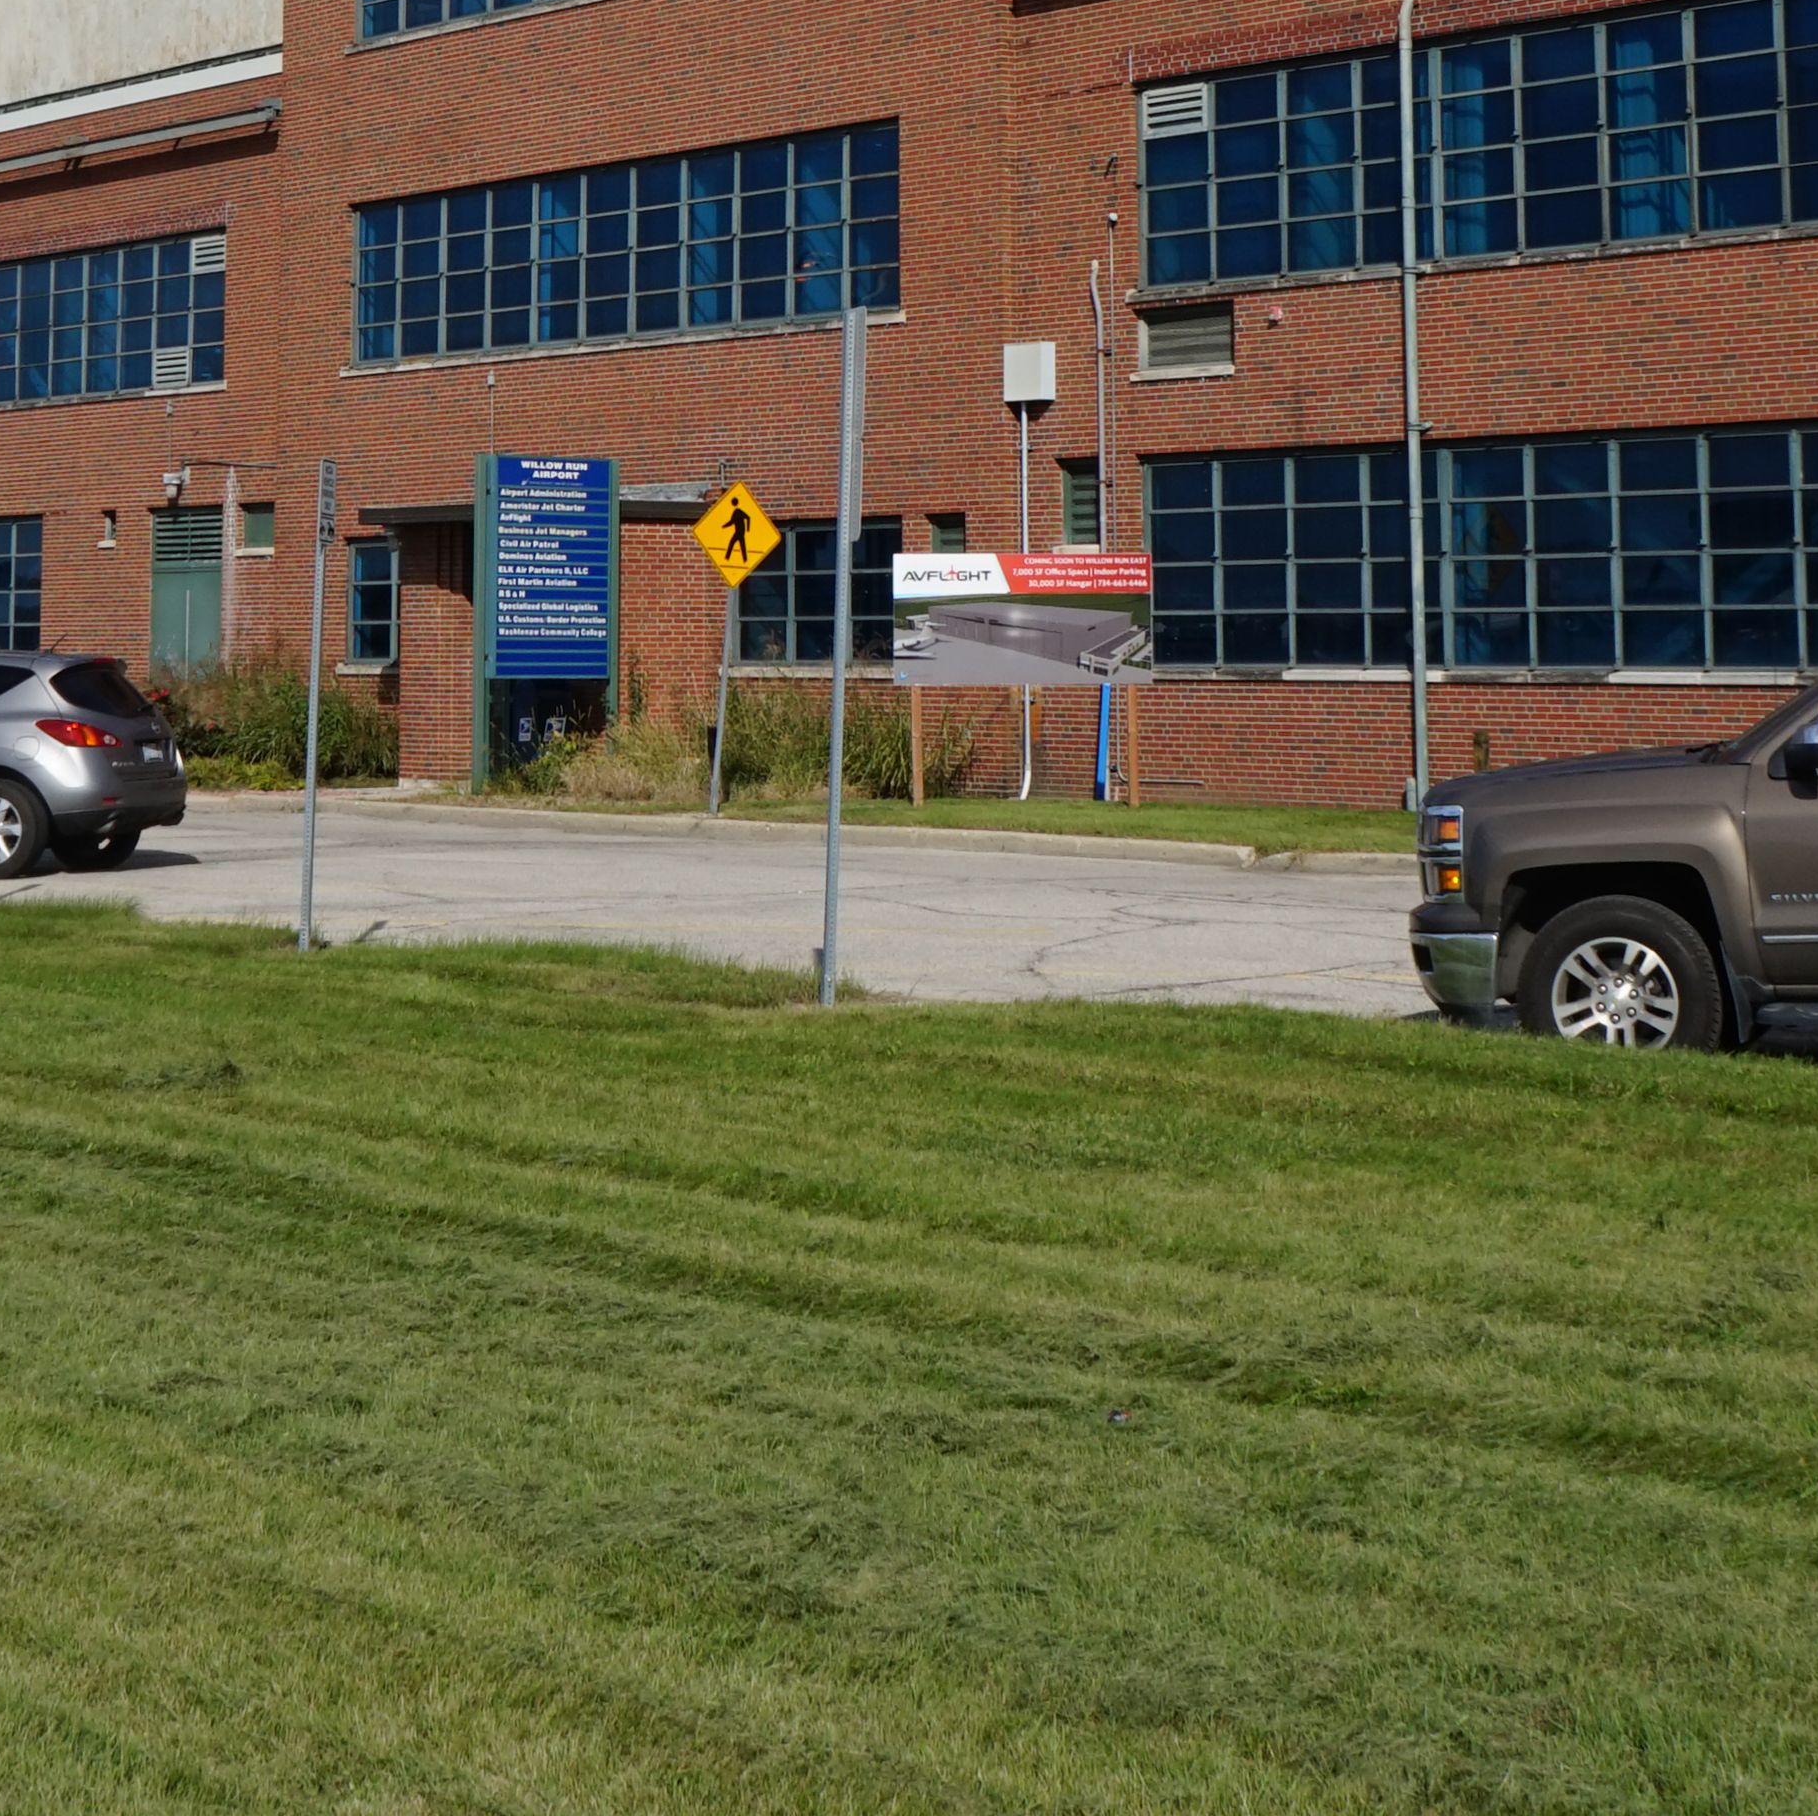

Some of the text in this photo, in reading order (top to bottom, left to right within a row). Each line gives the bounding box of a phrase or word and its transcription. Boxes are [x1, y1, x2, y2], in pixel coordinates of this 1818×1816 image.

[521, 460, 588, 471] WILLOW RUN
[532, 470, 580, 480] AIRPORT
[500, 488, 587, 499] Airport Administration
[500, 501, 586, 512] Ameristar Jet Charter
[498, 525, 588, 538] Business Jet Managers
[499, 539, 559, 549] Civil Air Patrol
[535, 552, 567, 561] Aviation
[1024, 557, 1147, 565] COMING SOON TO WILLOW RUN EAST
[498, 565, 514, 574] ELK
[515, 565, 527, 574] Air
[528, 565, 563, 574] Partners
[573, 567, 589, 575] LLC
[1067, 568, 1089, 577] Space
[1118, 568, 1146, 576] Parking
[498, 577, 577, 586] First Martin Aviation
[1056, 579, 1065, 587] SF
[1066, 579, 1092, 588] Hangar
[498, 601, 598, 613] Specialized Global Logistics
[570, 616, 606, 624] Protection
[498, 627, 607, 638] Washtenaw Community College
